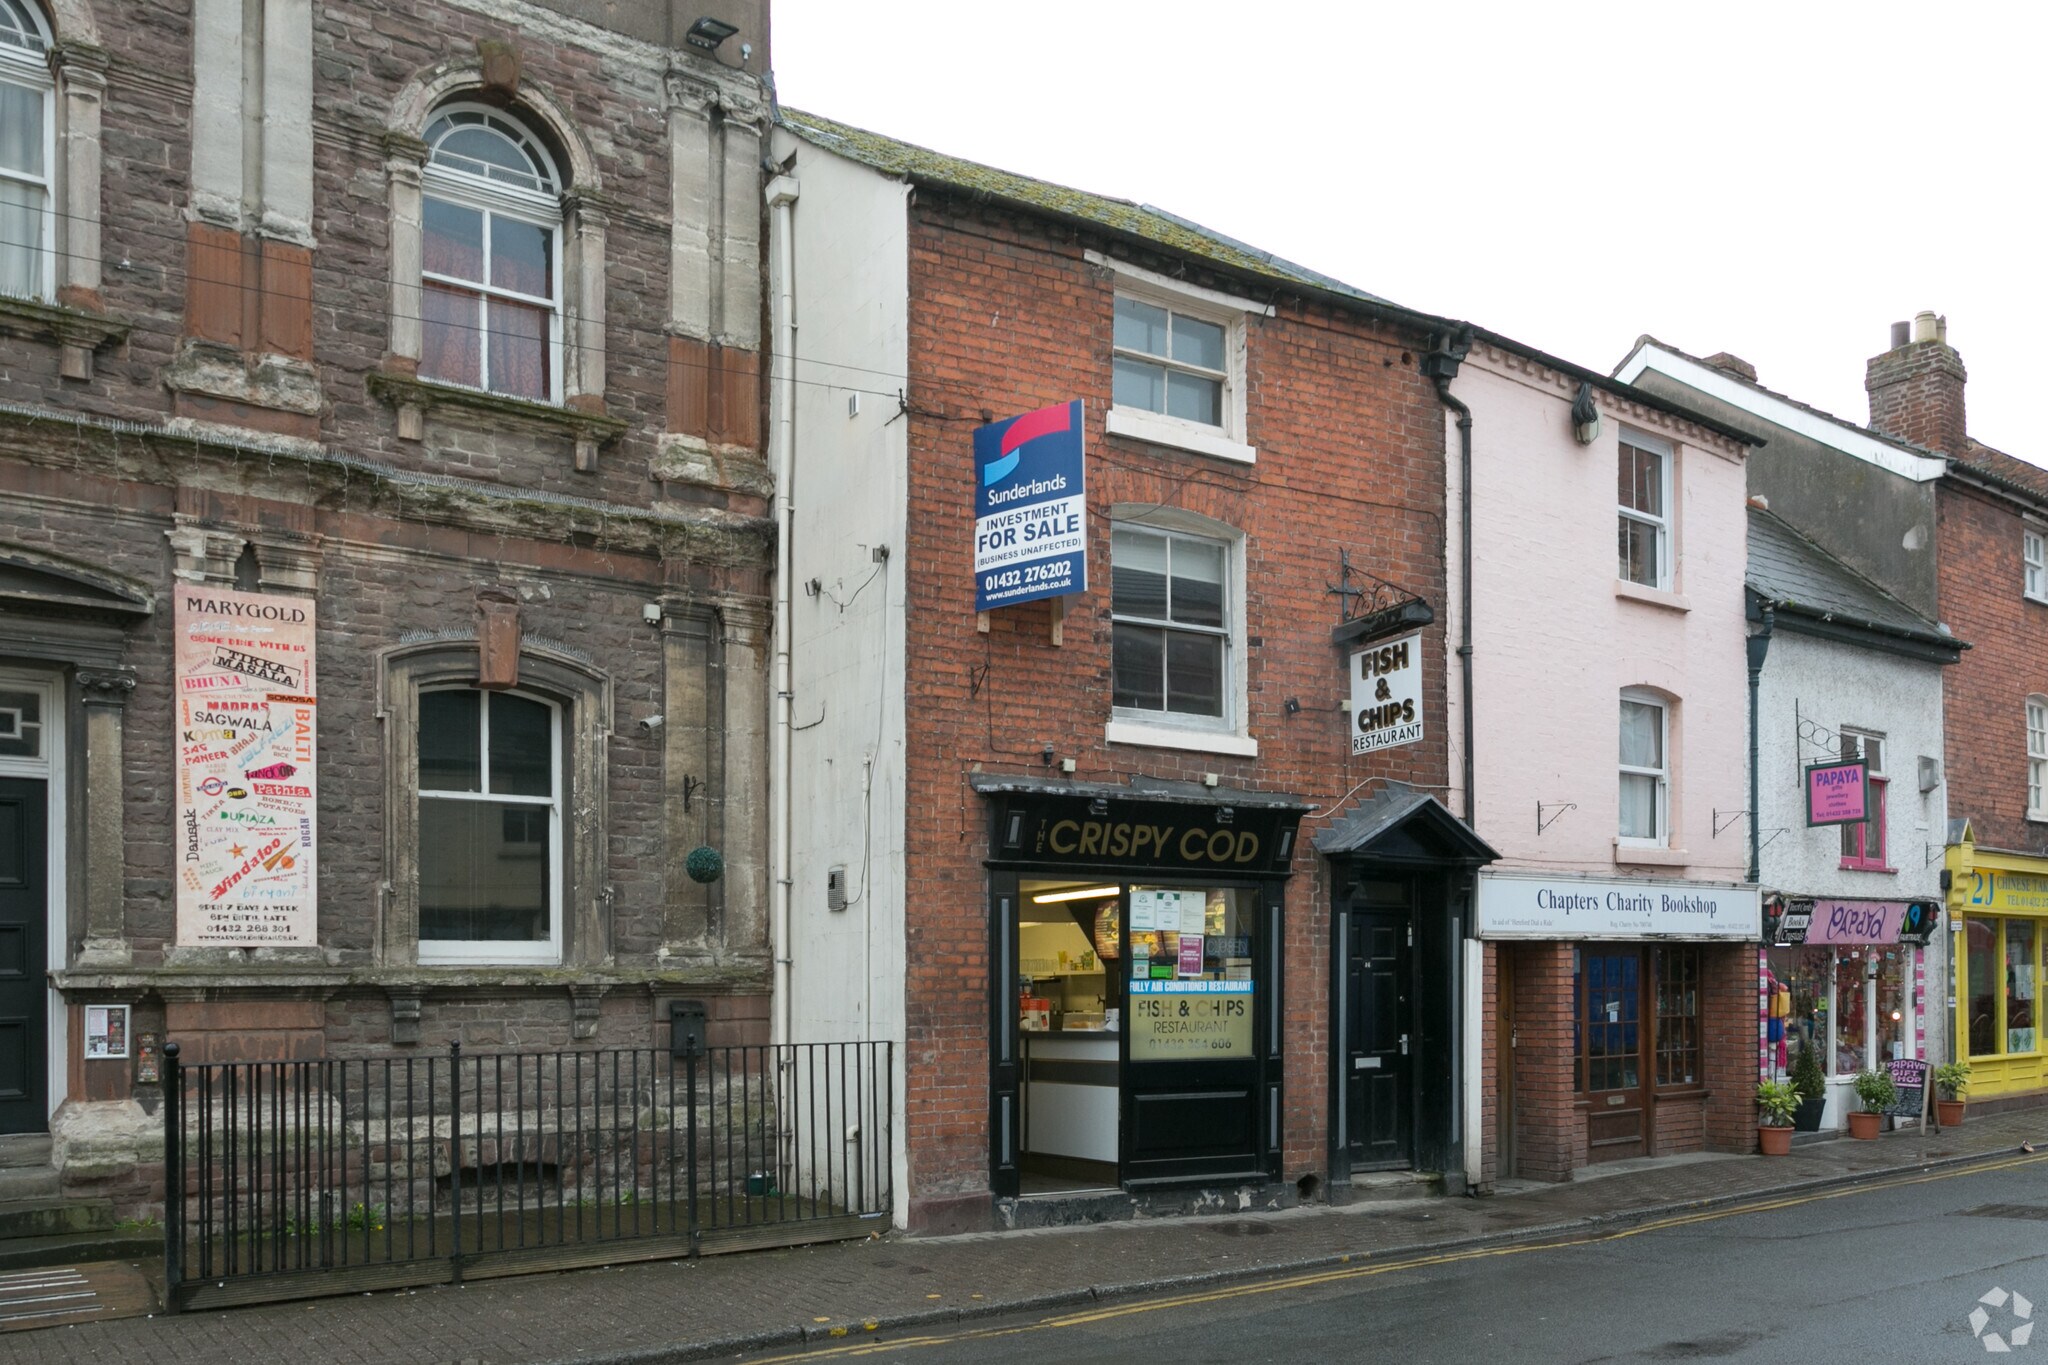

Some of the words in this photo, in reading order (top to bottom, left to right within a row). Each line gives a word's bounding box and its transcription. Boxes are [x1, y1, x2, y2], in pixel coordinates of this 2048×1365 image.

[988, 473, 1067, 506] Sunderlands
[986, 502, 1069, 531] INVESTMENT
[978, 528, 1016, 553] FOR
[1023, 513, 1080, 540] SALE
[977, 549, 1018, 568] (BUSINESS
[1020, 537, 1081, 556] UNAFFECTED)
[985, 569, 1021, 591] 01432
[1024, 560, 1072, 584] 276202
[985, 577, 1071, 601] www.sunderlands.co.uk
[187, 597, 305, 623] MARYGOLD
[190, 634, 224, 645] COME
[259, 640, 290, 651] WITH
[229, 650, 286, 675] TIKKA
[1361, 641, 1409, 681] FISH
[217, 656, 294, 686] MASALA
[185, 675, 242, 690] BHUNA
[1374, 677, 1392, 702] &
[207, 701, 270, 712] MADRAS
[267, 694, 314, 703] SOMOSA
[194, 711, 272, 732] SAGWALA
[1357, 698, 1415, 733] CHIPS
[229, 732, 258, 756] BHAJI
[295, 709, 311, 762] BALTI
[1353, 724, 1421, 752] RESTAURANT
[182, 743, 208, 755] SAG
[185, 751, 229, 766] PANEER
[1816, 769, 1859, 787] PAPAYA
[221, 811, 276, 825] DUPIAZA
[1035, 818, 1046, 853] THE
[1049, 819, 1174, 858] CRISPY
[1179, 827, 1259, 863] COD
[1997, 875, 2030, 892] CHINESE
[198, 903, 222, 911] OPEN
[237, 903, 259, 911] DAYS
[1537, 888, 1599, 915] Chapters
[1606, 891, 1654, 917] Charity
[1661, 894, 1717, 918] Bookshop
[2007, 895, 2020, 906] TEL
[207, 925, 242, 933] 01432
[247, 925, 268, 933] 268
[1788, 916, 1805, 926] Books
[1781, 930, 1804, 942] Crystals
[1129, 981, 1149, 992] FULLY
[1151, 981, 1163, 992] AIR
[1165, 981, 1208, 992] CONDITIONED
[1208, 981, 1251, 992] RESTAURANT
[1138, 1000, 1172, 1017] FISH
[1178, 1000, 1190, 1017] &
[1195, 1000, 1245, 1017] CHIPS
[1154, 1020, 1228, 1034] RESTAURANT
[1149, 1039, 1184, 1049] 01432
[1211, 1039, 1232, 1049] 606
[1887, 1060, 1926, 1070] PAPAYA
[1891, 1069, 1919, 1077] GIFT
